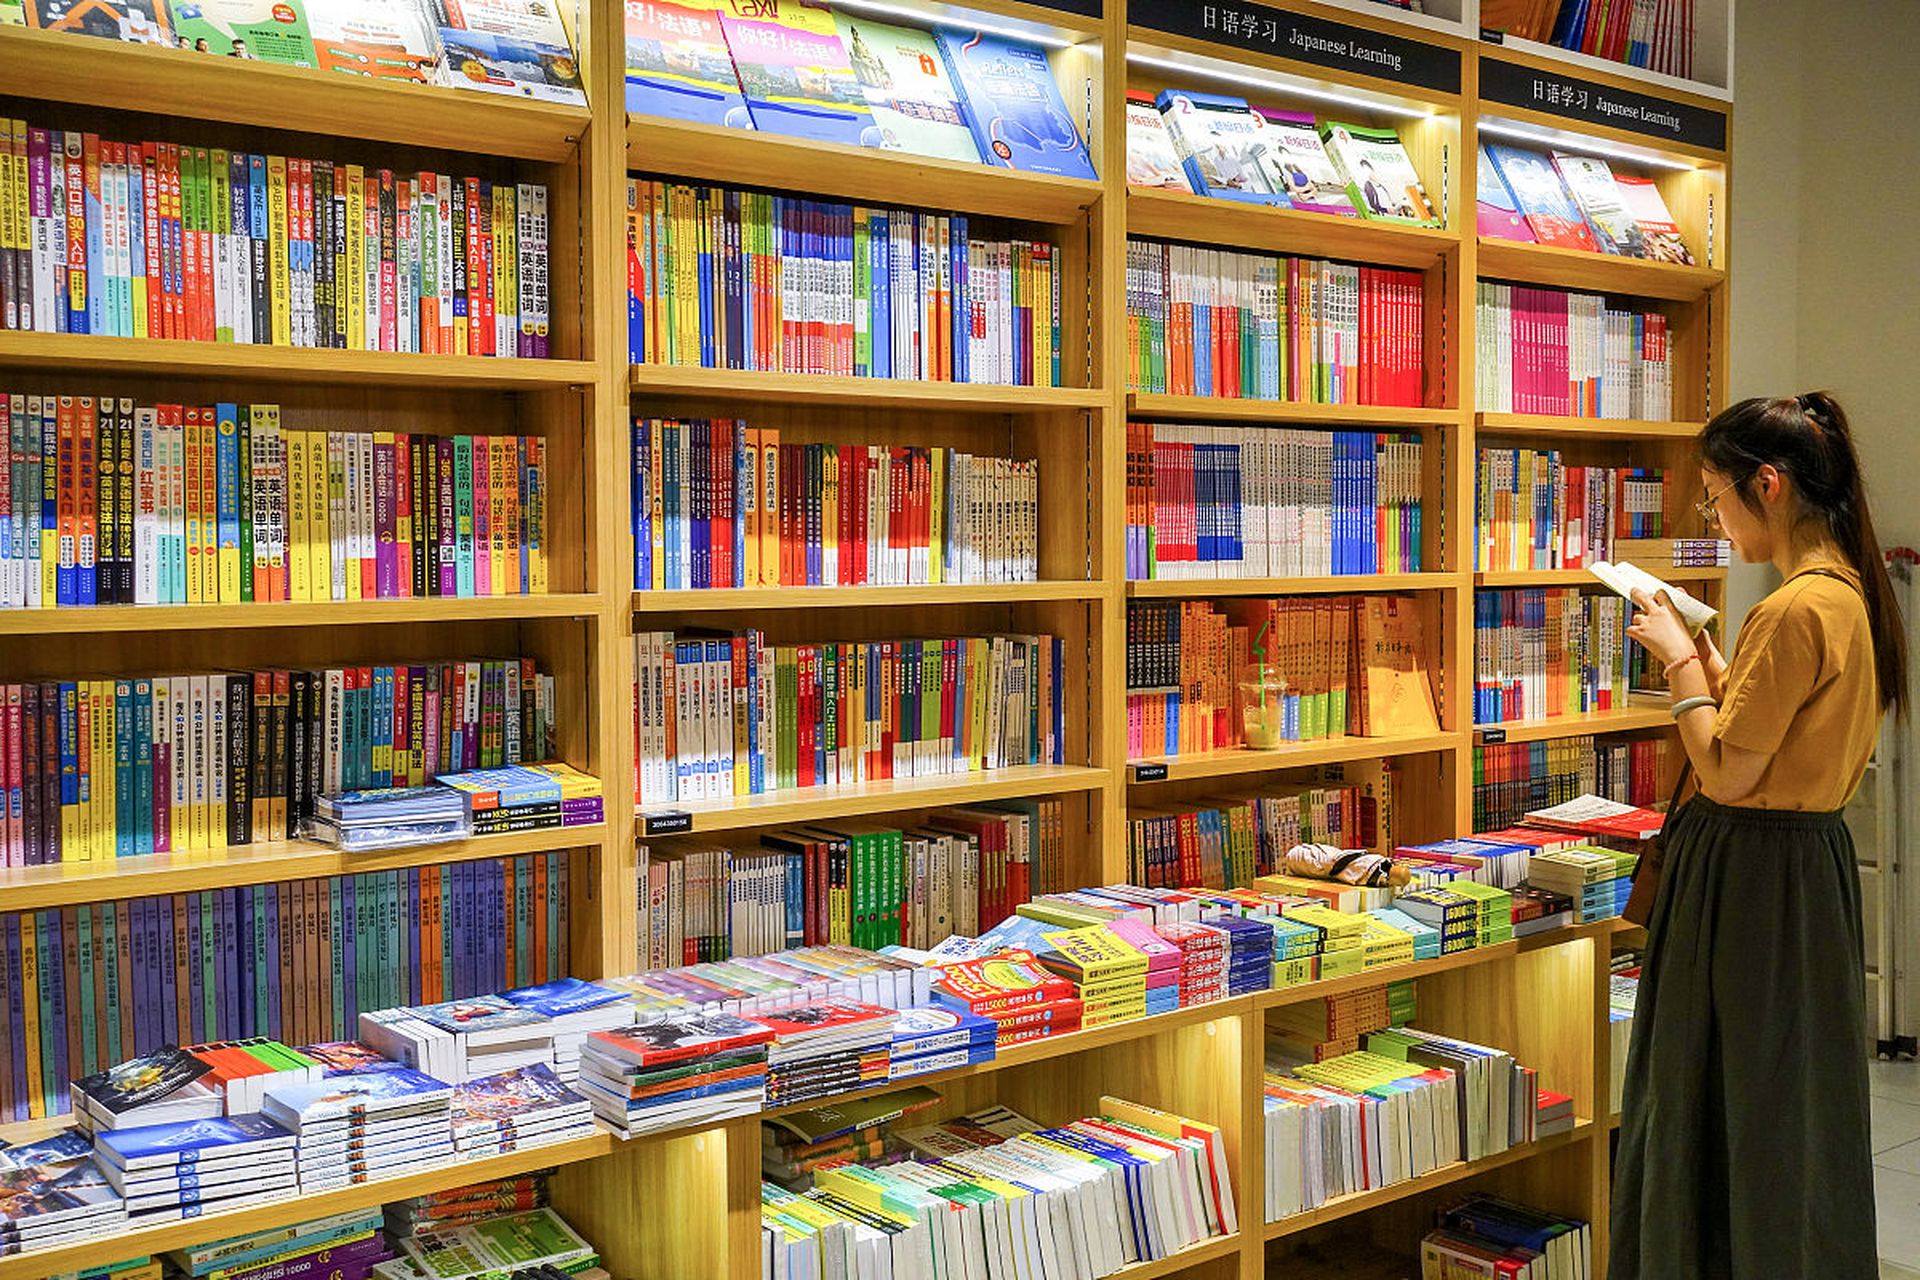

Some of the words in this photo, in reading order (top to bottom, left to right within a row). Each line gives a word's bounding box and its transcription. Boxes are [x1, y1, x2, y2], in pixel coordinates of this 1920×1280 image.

[737, 24, 832, 61] 你好!法语
[1204, 5, 1277, 43] 日语学习
[1289, 28, 1347, 56] Japanese
[1350, 41, 1402, 71] Learning
[1177, 99, 1191, 114] 2
[1251, 113, 1265, 129] 3
[1533, 79, 1589, 110] 日语学习
[1596, 97, 1639, 120] Japanese
[1641, 106, 1681, 132] Learning
[67, 163, 84, 263] 英语口语30天入门
[254, 478, 268, 544] 英语单词
[268, 479, 283, 545] 英语单词
[233, 683, 244, 767] 我可能学的是假英语
